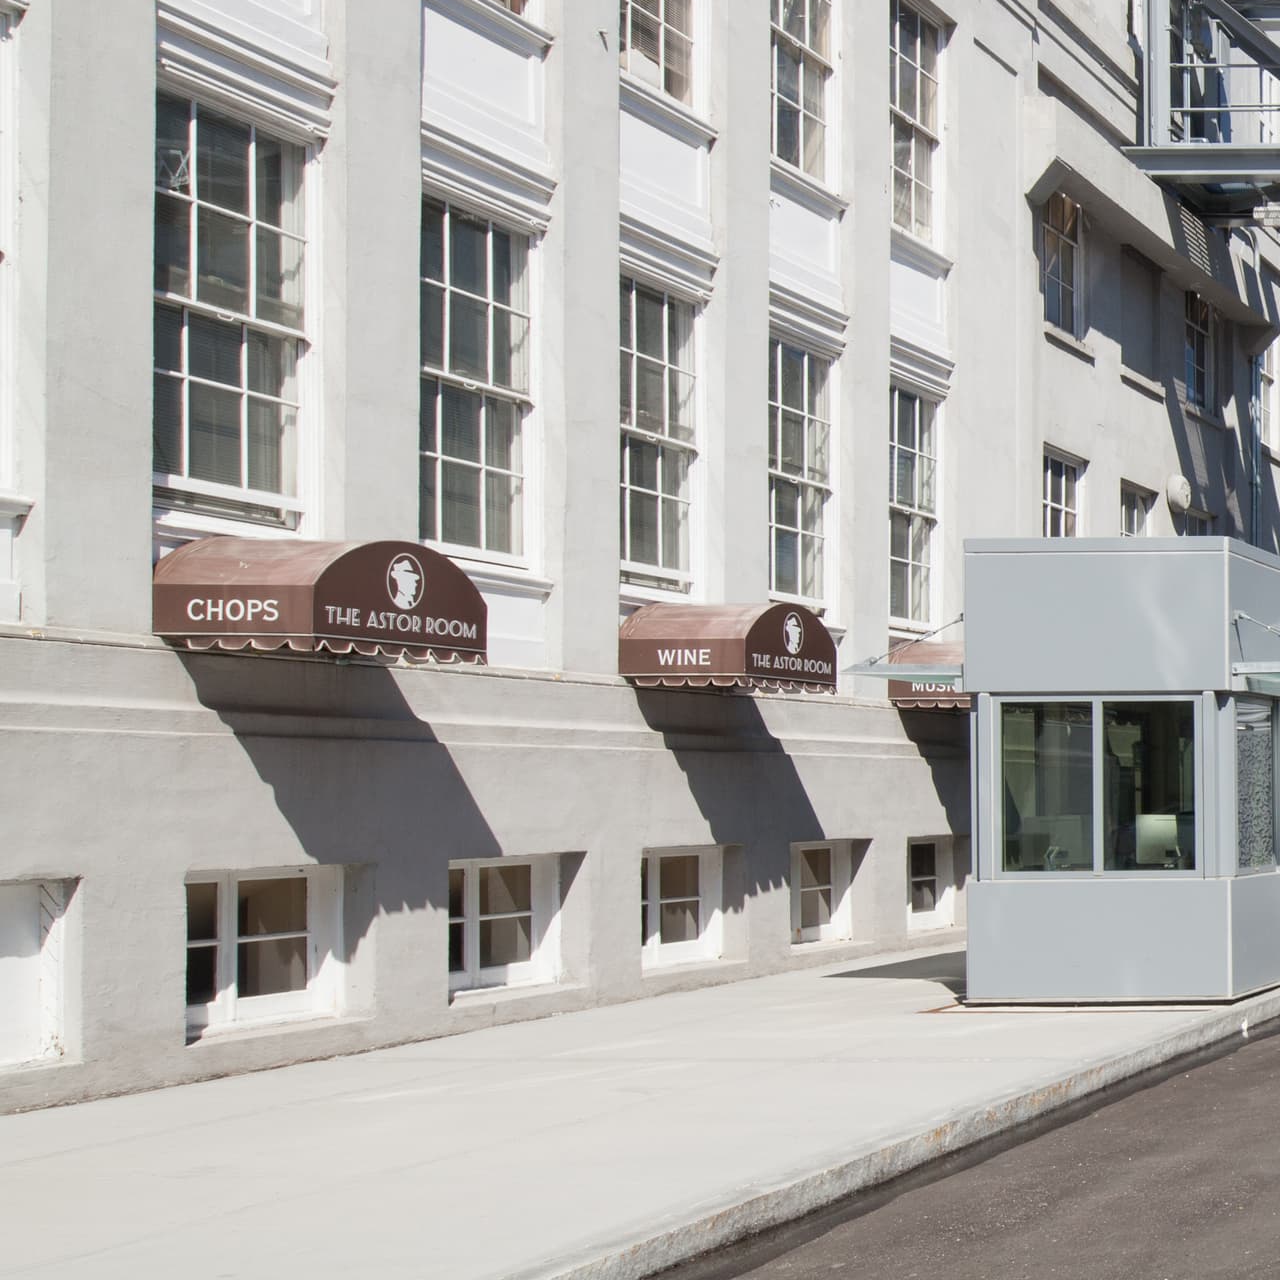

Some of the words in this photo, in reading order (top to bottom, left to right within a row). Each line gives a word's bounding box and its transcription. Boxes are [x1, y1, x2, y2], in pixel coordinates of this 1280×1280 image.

[186, 598, 280, 622] CHOPS
[325, 605, 361, 627] THE
[366, 611, 422, 633] ASTOR
[425, 616, 478, 639] ROOM
[657, 648, 711, 666] WINE
[752, 653, 771, 669] THE
[773, 655, 803, 673] ASTOR
[803, 658, 832, 676] ROOM
[911, 681, 956, 693] MUSI
